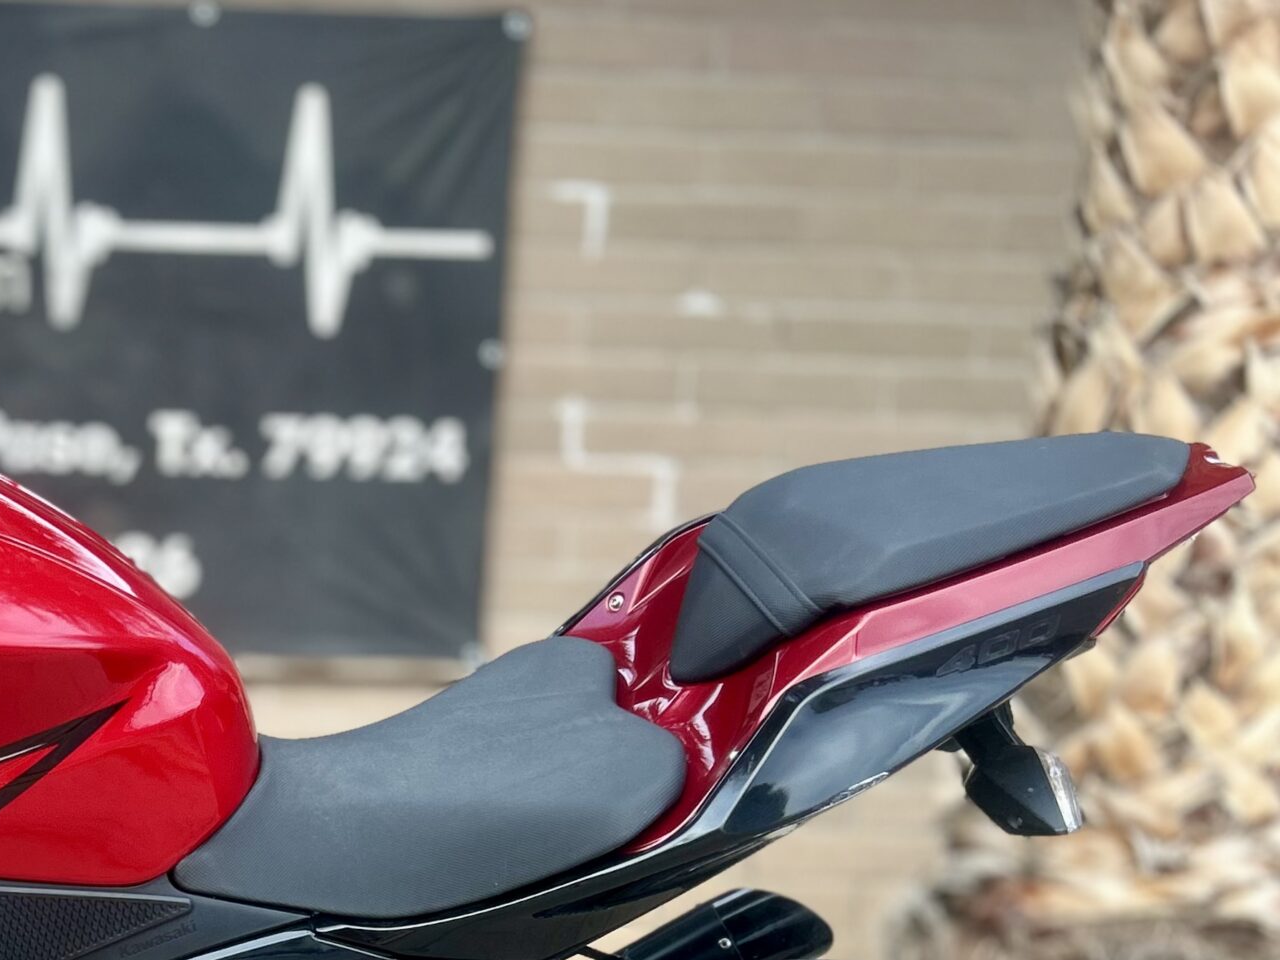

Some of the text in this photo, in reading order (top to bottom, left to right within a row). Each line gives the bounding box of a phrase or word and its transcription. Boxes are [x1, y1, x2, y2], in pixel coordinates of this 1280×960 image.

[258, 411, 468, 484] 79924
[936, 612, 1061, 677] 400
[119, 920, 198, 958] Kawasaki
